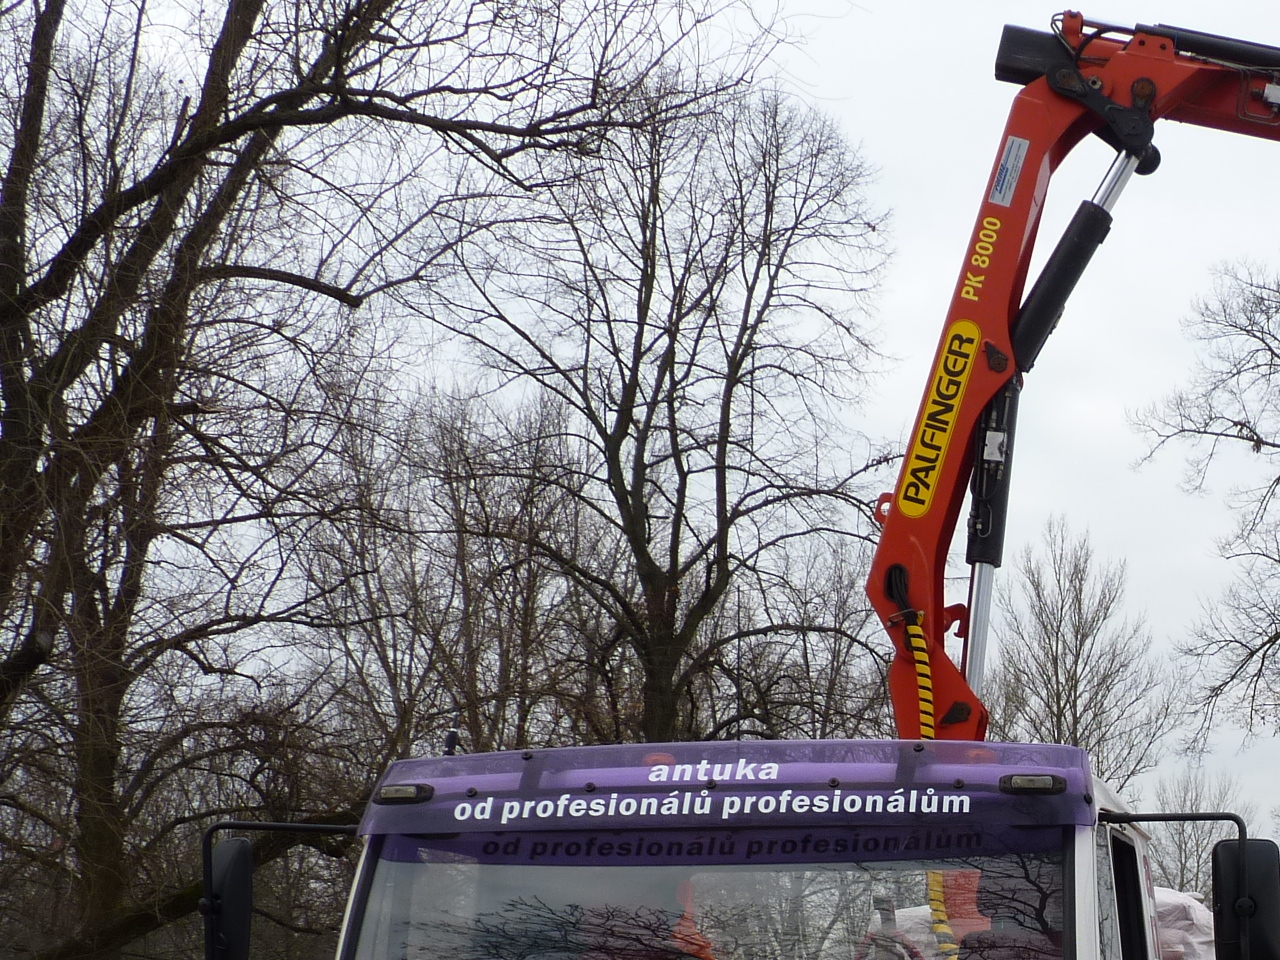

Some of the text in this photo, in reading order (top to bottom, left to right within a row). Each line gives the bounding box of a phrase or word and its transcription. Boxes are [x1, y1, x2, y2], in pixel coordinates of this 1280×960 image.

[971, 215, 1001, 268] 8000
[961, 271, 985, 302] PK
[903, 333, 976, 506] PALFINGER
[648, 758, 780, 782] antuka
[454, 789, 971, 824] od profesionálů profesionálům
